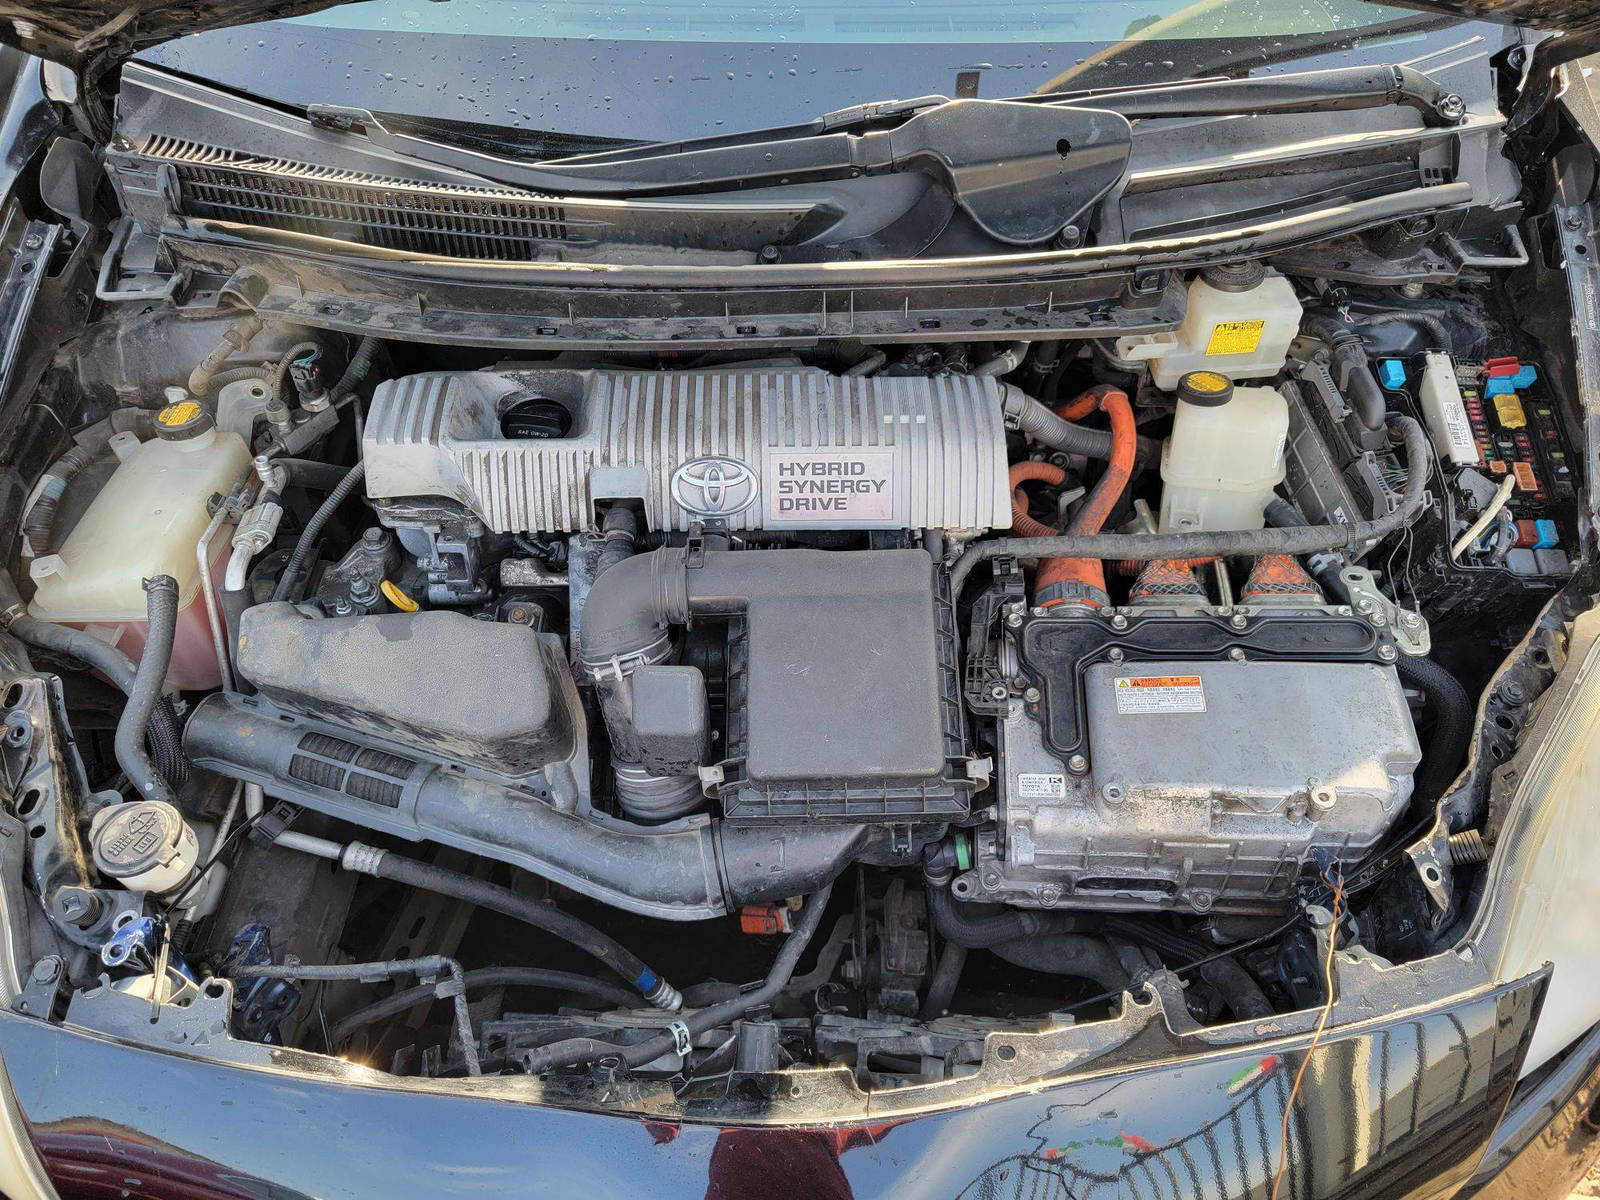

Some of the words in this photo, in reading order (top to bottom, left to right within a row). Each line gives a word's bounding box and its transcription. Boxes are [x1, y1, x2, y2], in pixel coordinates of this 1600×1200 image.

[778, 461, 866, 476] HYBRID
[778, 479, 887, 494] SYNERGY
[778, 497, 848, 511] DRIVE
